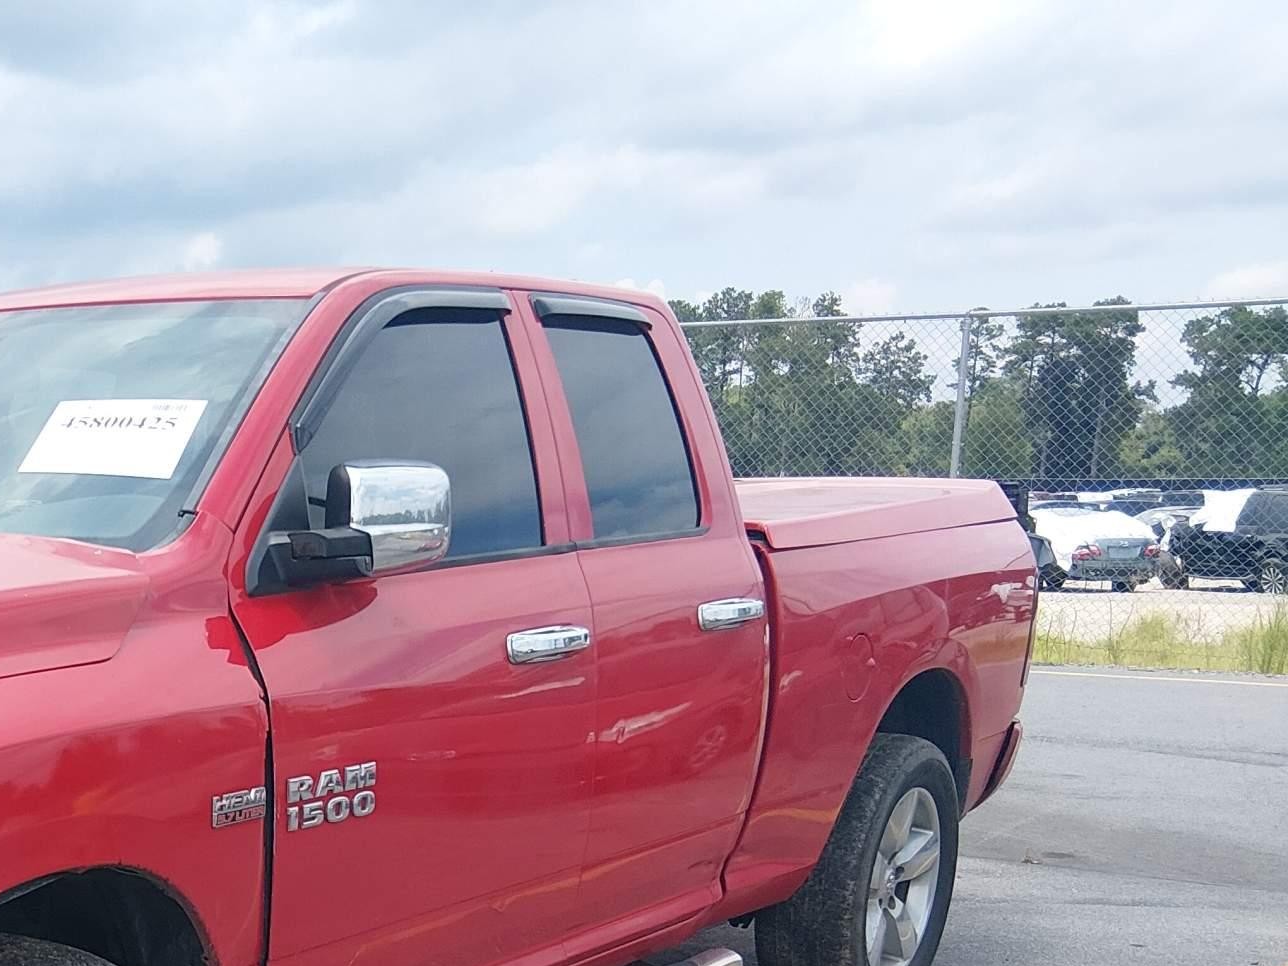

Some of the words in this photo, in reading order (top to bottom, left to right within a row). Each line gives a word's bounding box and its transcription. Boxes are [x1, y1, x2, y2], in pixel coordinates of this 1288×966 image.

[62, 416, 178, 430] 45800425
[288, 761, 377, 803] RAM
[212, 786, 266, 814] HEMI
[287, 790, 376, 832] 1500
